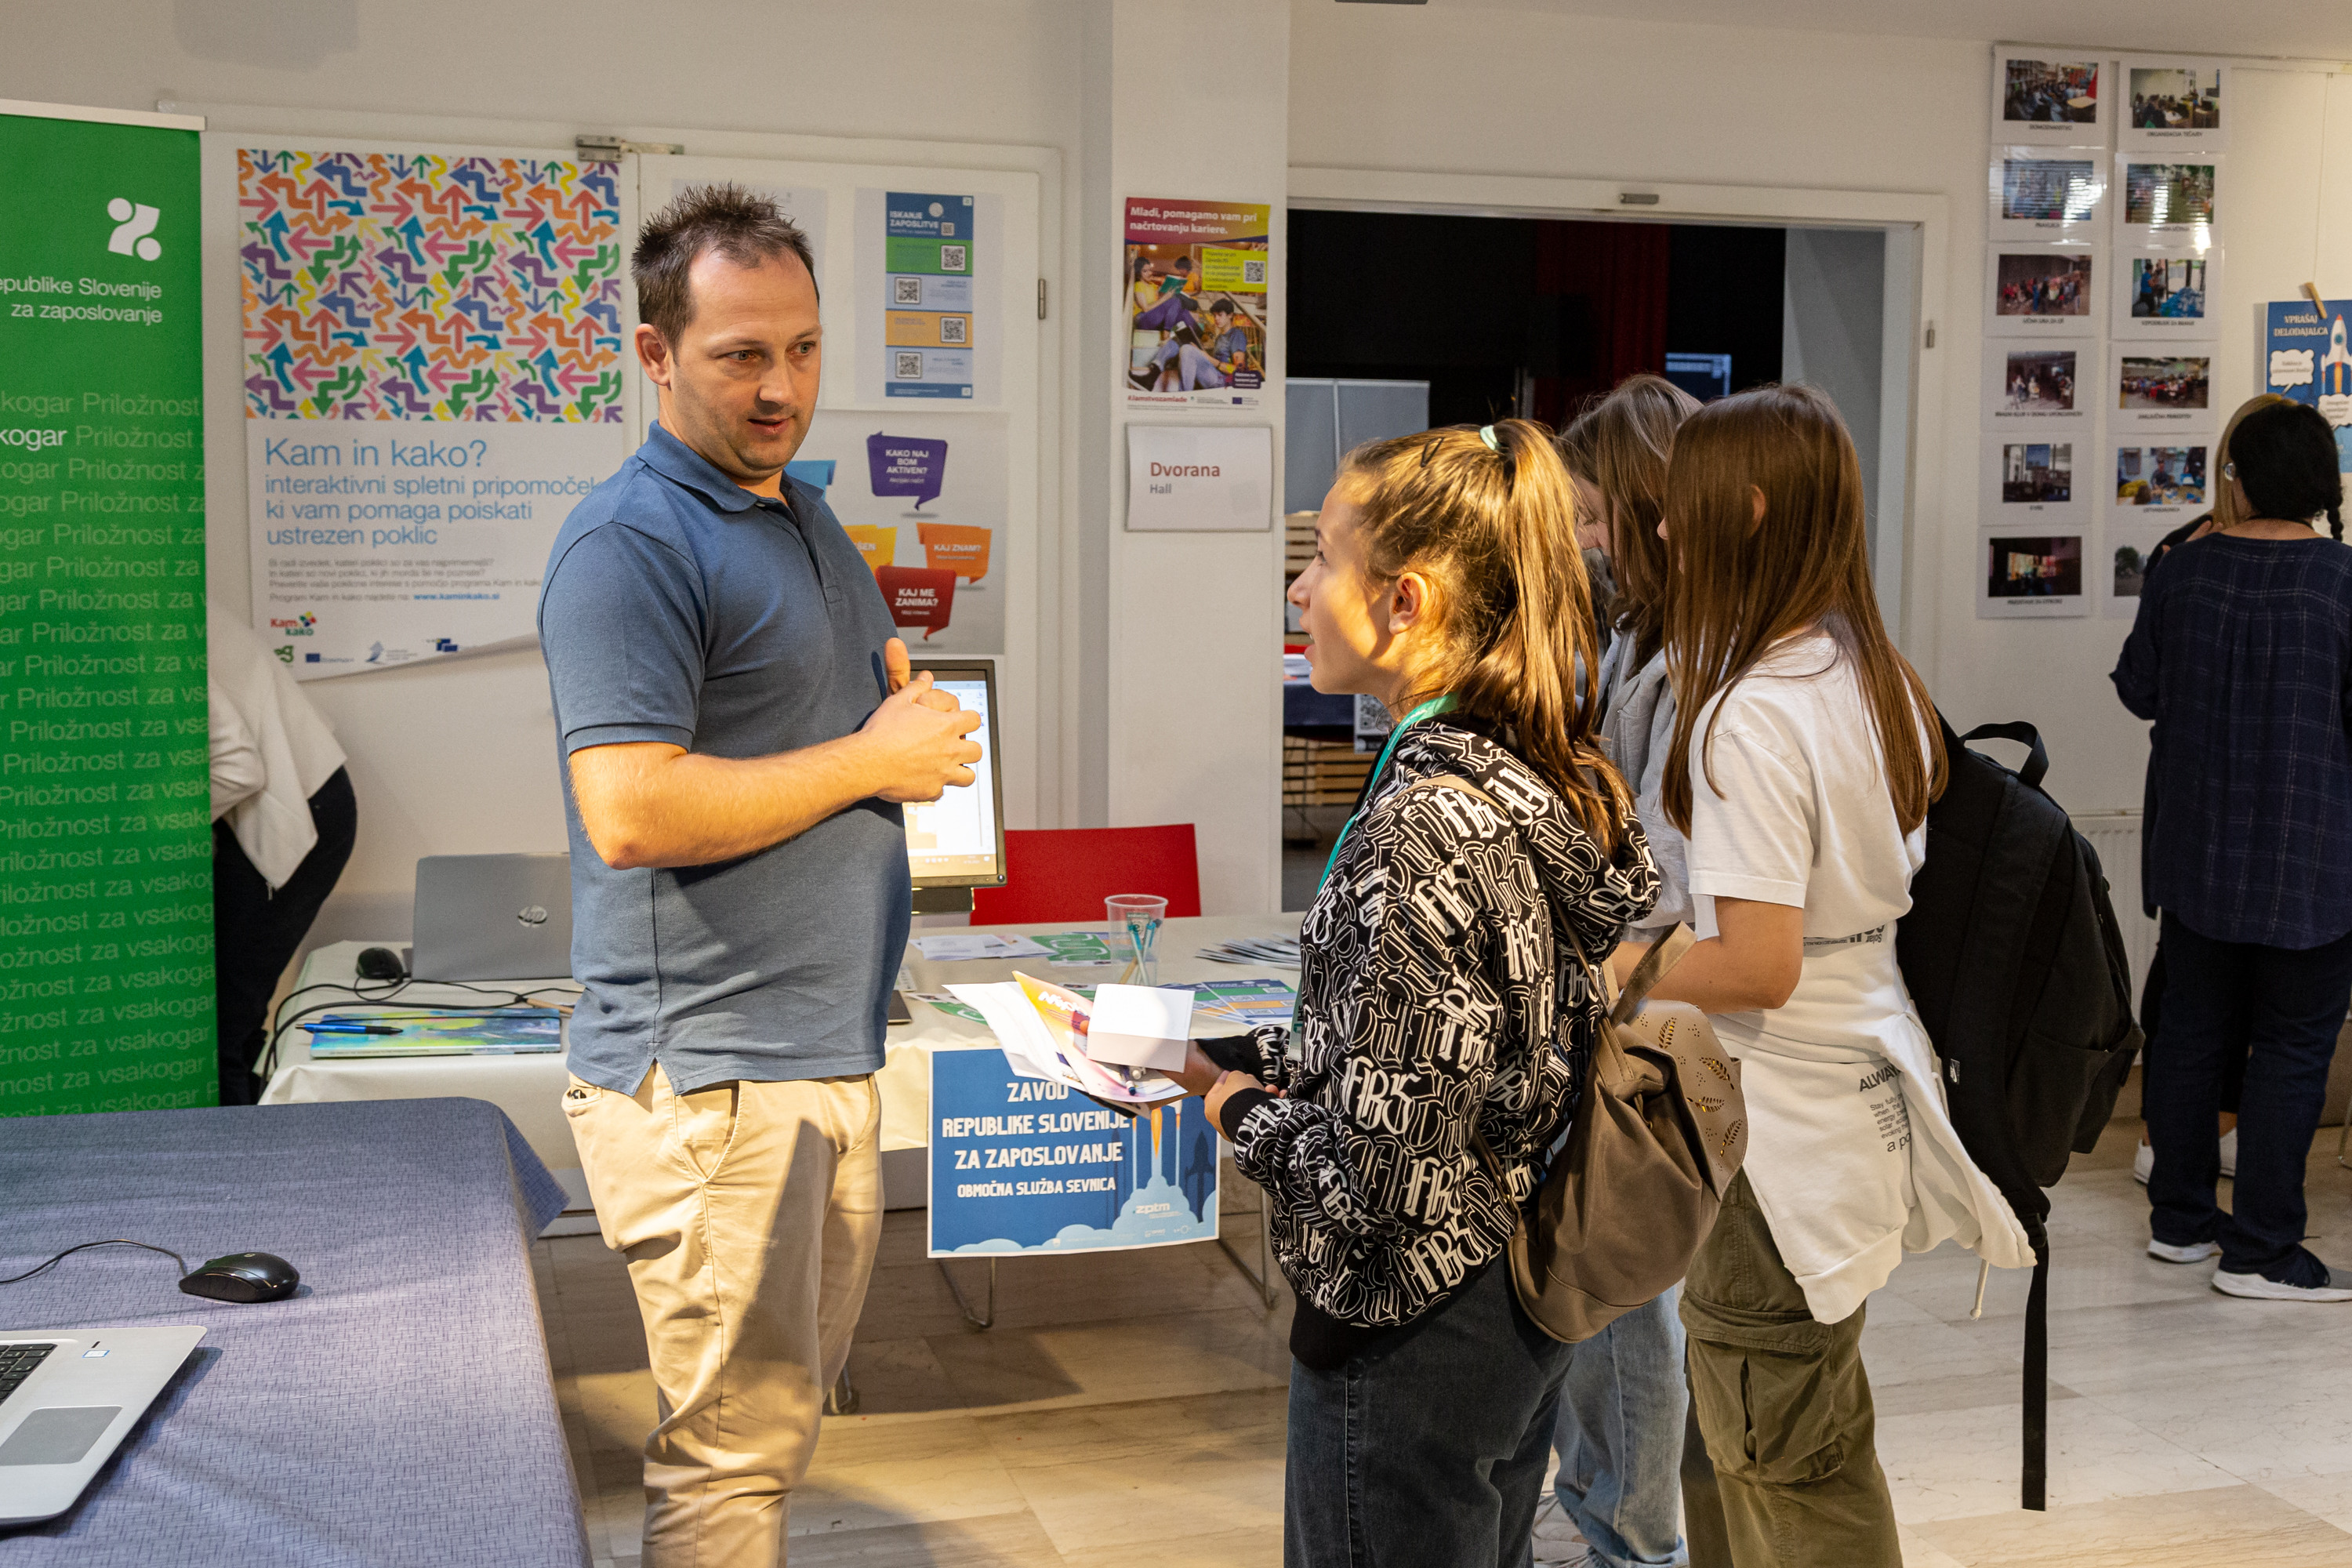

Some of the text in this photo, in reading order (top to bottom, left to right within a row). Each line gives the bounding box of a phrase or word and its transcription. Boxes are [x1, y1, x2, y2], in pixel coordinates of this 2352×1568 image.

[1130, 205, 1257, 223] Mladi, pomagamo vam pri
[1130, 220, 1228, 235] načrtovanju kariere.
[78, 278, 162, 301] Slovenije
[11, 304, 162, 326] za zaposlovanje
[82, 392, 199, 416] Priložnost
[75, 425, 193, 448] Priložnost
[266, 438, 487, 467] Kam in kako?
[912, 450, 929, 459] NAJ
[0, 457, 187, 485] ogar Priložnost
[887, 466, 928, 474] AKTIVEN?
[1150, 462, 1221, 477] Dvorana
[265, 475, 386, 495] interaktivni
[394, 475, 465, 499] spletni
[1149, 484, 1172, 494] Hall
[60, 491, 179, 513] Priložnost
[265, 500, 532, 524] ki vam pomaga poiskati
[0, 528, 44, 550] gar
[53, 524, 172, 545] Priložnost
[267, 524, 437, 549] ustrezen poklic
[952, 544, 982, 553] ZNAM?
[46, 557, 166, 578] Priložnost
[175, 559, 199, 576] za
[39, 590, 159, 610] Priložnost
[168, 592, 193, 608] za
[895, 597, 938, 607] ZANIMA?
[898, 588, 935, 597] KAJ ME
[32, 621, 153, 644] Priložnost
[162, 624, 187, 641] za
[270, 618, 298, 628] Kam
[285, 627, 314, 637] kako
[24, 654, 147, 677] Priložnost
[154, 655, 181, 673] za
[17, 687, 138, 709] Priložnost
[147, 688, 174, 705] za
[10, 718, 132, 742] Priložnost
[140, 719, 168, 737] za
[3, 750, 125, 775] Priložnost
[132, 751, 161, 769] za
[126, 784, 154, 801] za
[119, 816, 147, 833] za
[112, 848, 140, 865] za
[104, 880, 133, 897] za
[98, 912, 126, 929] za
[91, 943, 118, 961] za
[84, 975, 112, 993] za
[76, 1007, 105, 1025] za
[70, 1039, 98, 1057] za
[105, 1026, 211, 1052] vsakogar
[62, 1071, 90, 1090] za
[98, 1058, 205, 1085] vsakogar
[1007, 1081, 1069, 1103] ZAVOD
[1870, 1102, 1884, 1111] Stay
[942, 1109, 1131, 1138] REPUBLIKE SLOVENIJE
[1877, 1114, 1896, 1125] energy
[954, 1142, 1123, 1170] ZA ZAPOSLOVANJE
[1886, 1141, 1896, 1152] a
[956, 1177, 1116, 1198] OBMOČNA SLUŽBA SEVNICA
[1134, 1203, 1171, 1214] zptm
